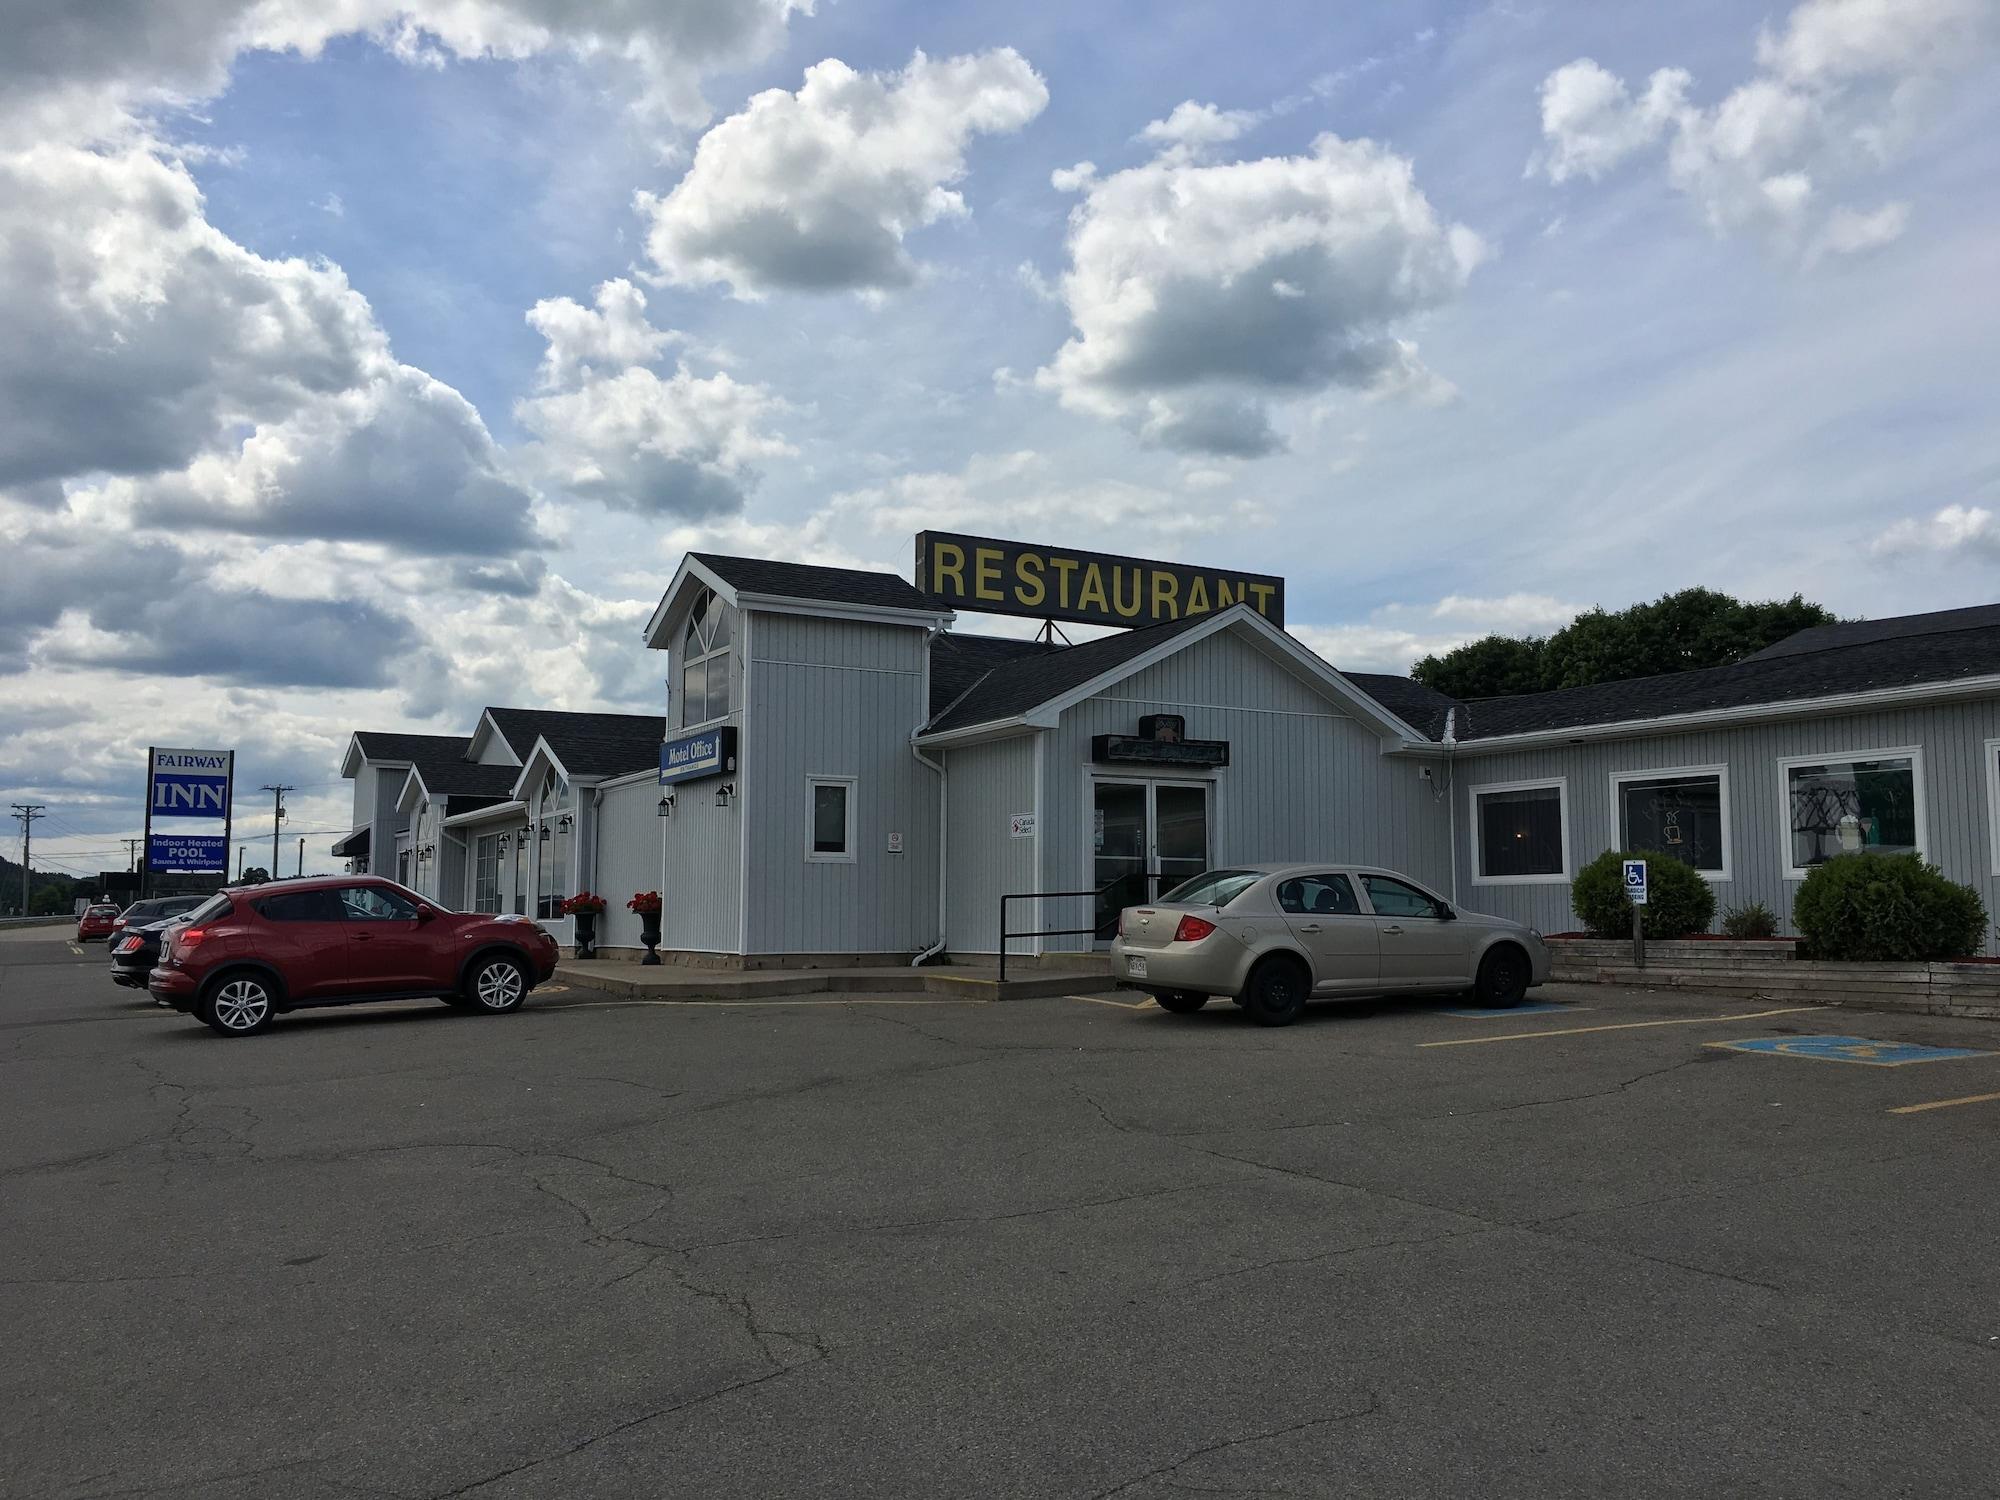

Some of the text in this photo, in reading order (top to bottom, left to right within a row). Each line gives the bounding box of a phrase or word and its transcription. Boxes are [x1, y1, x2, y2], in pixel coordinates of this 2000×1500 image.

[933, 542, 1276, 620] RESTAURANT
[669, 740, 712, 765] Motel Office
[157, 755, 226, 768] FAIRWAY
[155, 783, 225, 809] INN
[1019, 826, 1032, 834] Select
[152, 839, 223, 848] Indoor Heated
[168, 848, 207, 858] POOL
[186, 859, 223, 867] Whirlpool
